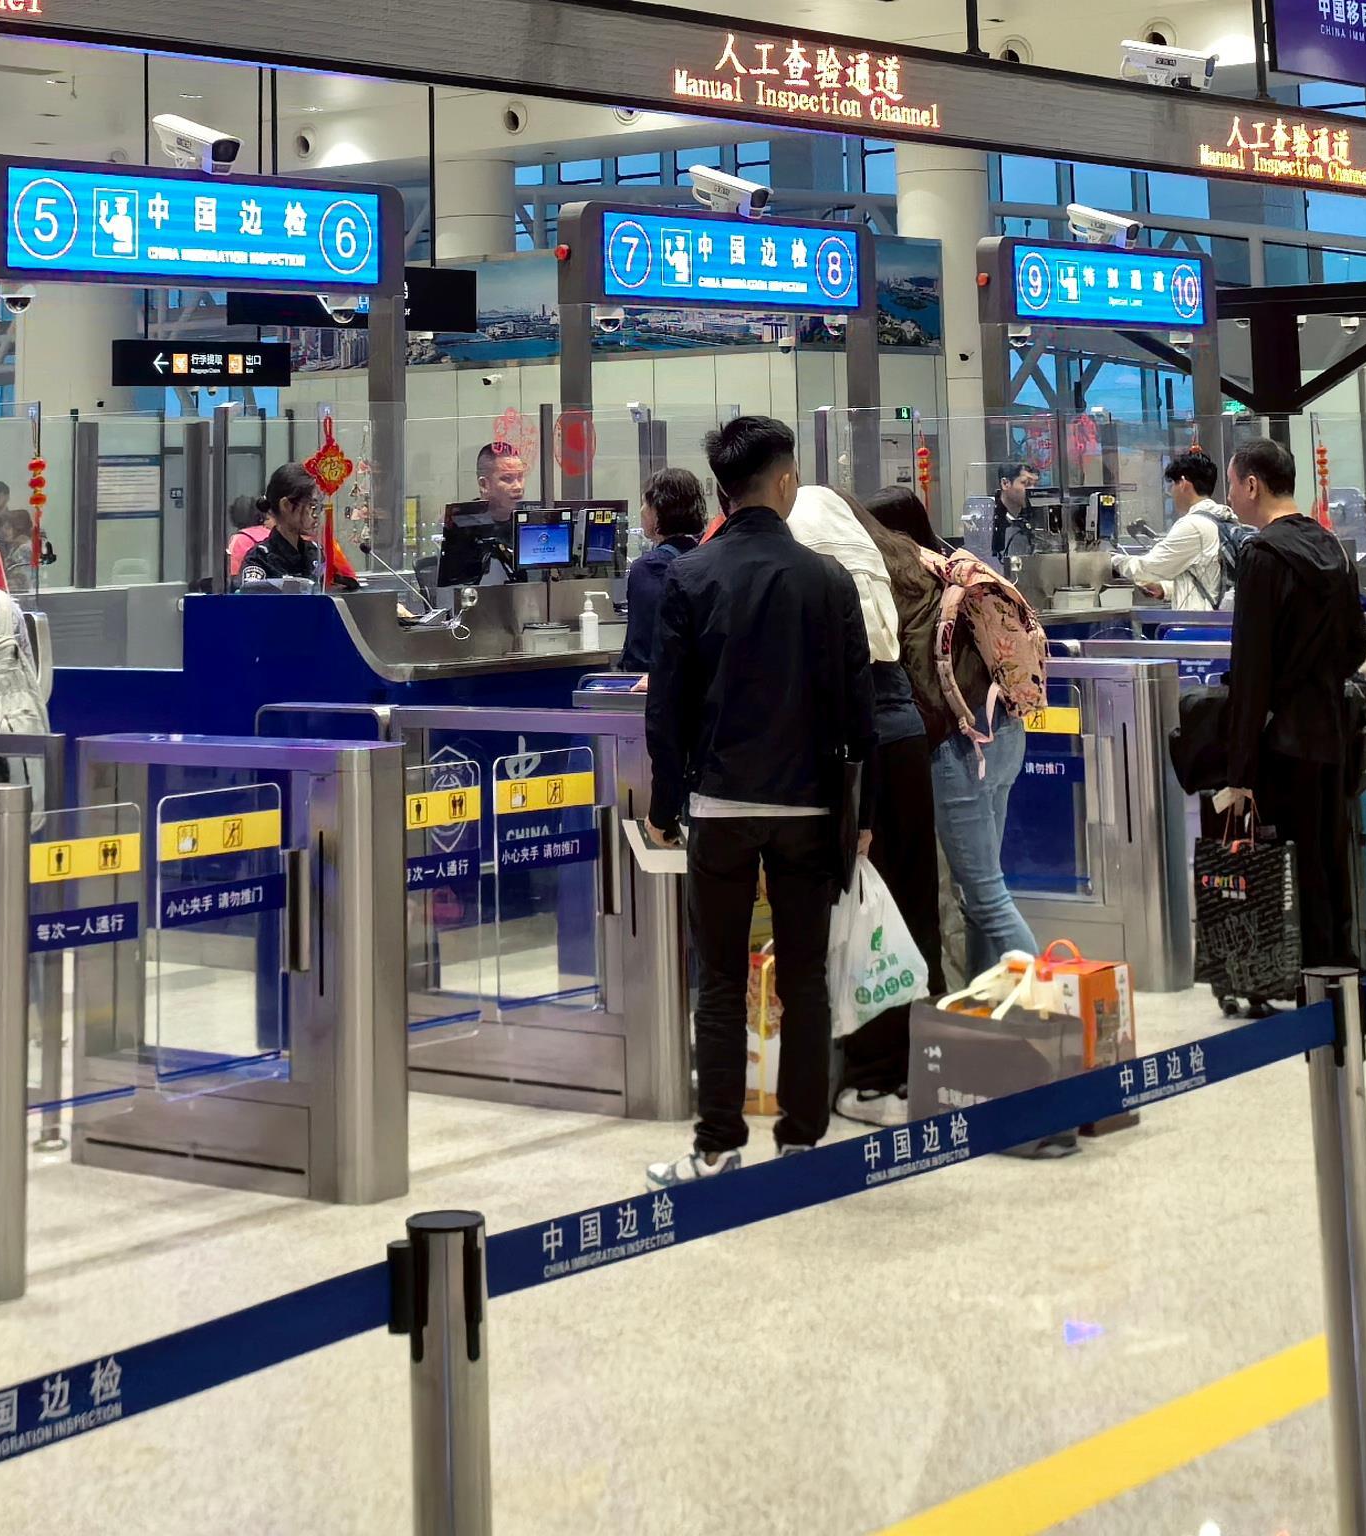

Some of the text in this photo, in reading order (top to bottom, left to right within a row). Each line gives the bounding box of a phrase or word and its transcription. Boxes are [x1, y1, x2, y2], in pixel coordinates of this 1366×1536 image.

[1320, 24, 1346, 39] CHINA
[715, 33, 904, 102] 人工查验通道
[674, 69, 940, 128] Manual Inspection Channel
[1226, 115, 1352, 167] 人工查验通道
[33, 197, 60, 242] 5
[147, 192, 308, 239] 中国边检
[335, 216, 357, 259] 6
[621, 236, 639, 272] 7
[827, 251, 842, 285] 8
[1028, 265, 1042, 298] 9
[1174, 275, 1197, 307] 10
[501, 839, 581, 865] 小心夹手 请勿推门
[166, 886, 263, 919] 小心夹手 请勿推门
[36, 914, 124, 942] 每次一人通行
[1119, 1043, 1207, 1095] 中国边检
[864, 1112, 970, 1169] 中国边检
[542, 1192, 675, 1261] 中国边检
[543, 1259, 572, 1278] CHINA
[625, 1231, 675, 1260] INSPECTION
[53, 1401, 123, 1439] INSPECTION
